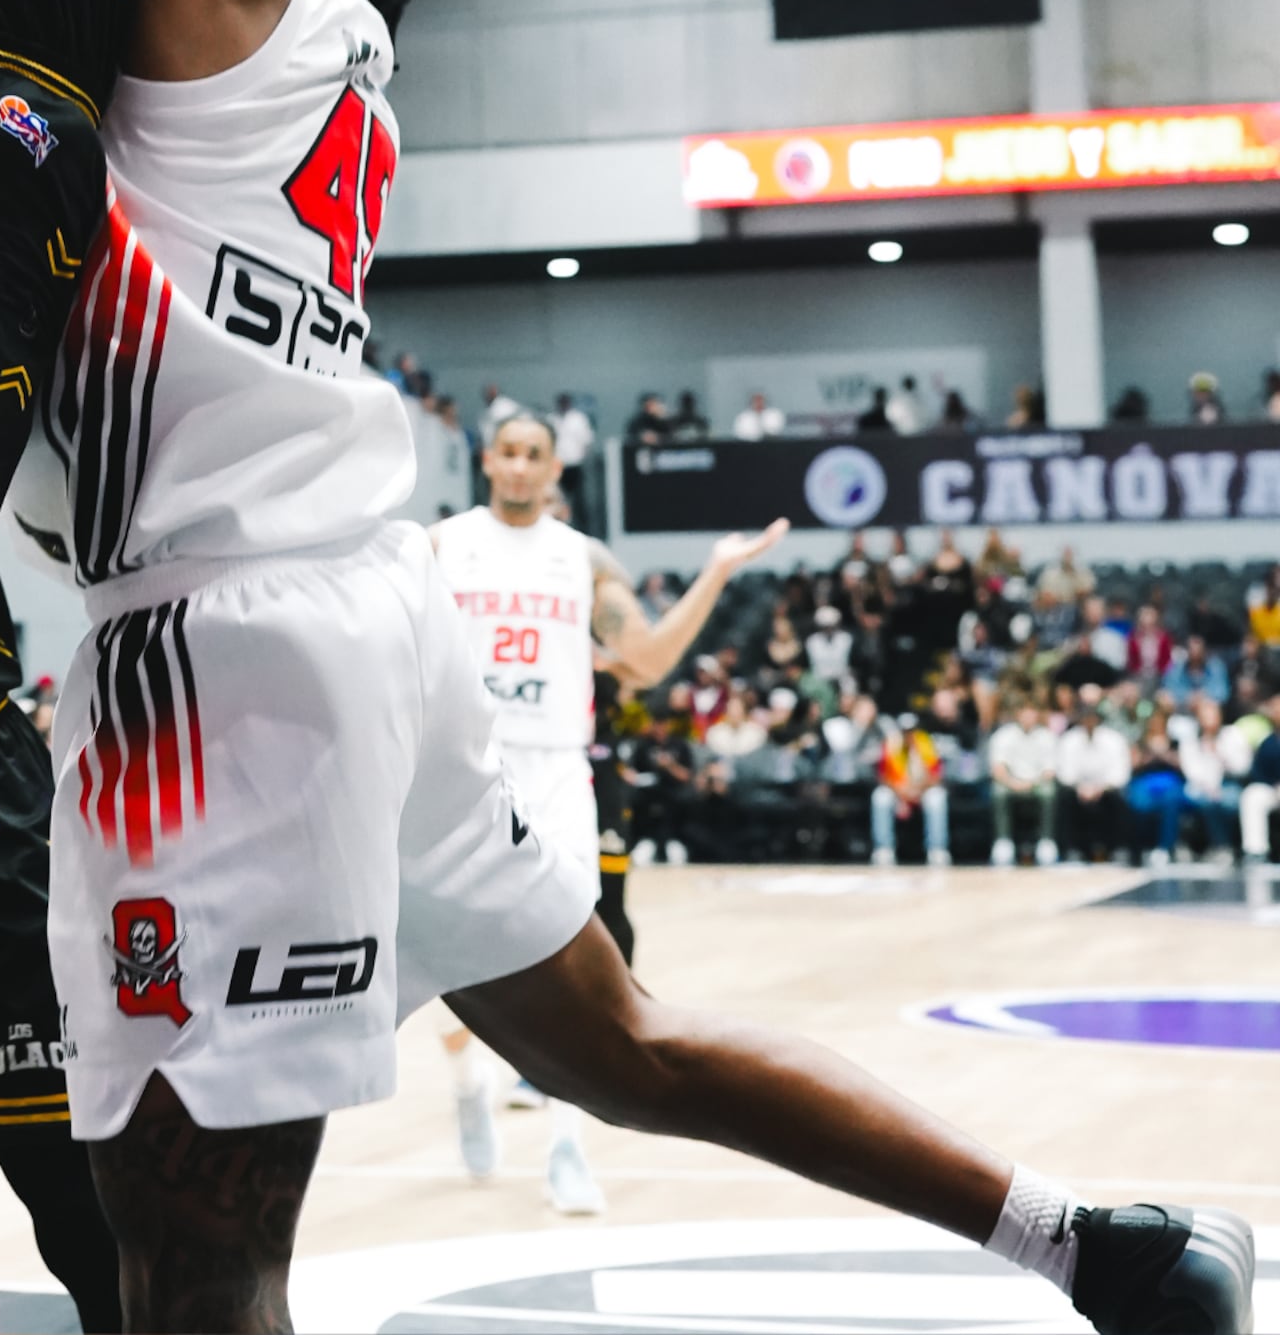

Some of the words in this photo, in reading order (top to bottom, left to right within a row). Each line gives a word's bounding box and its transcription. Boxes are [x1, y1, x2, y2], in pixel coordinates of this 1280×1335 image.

[493, 626, 540, 664] 20
[225, 936, 378, 1008] LED
[7, 1023, 33, 1041] LOS
